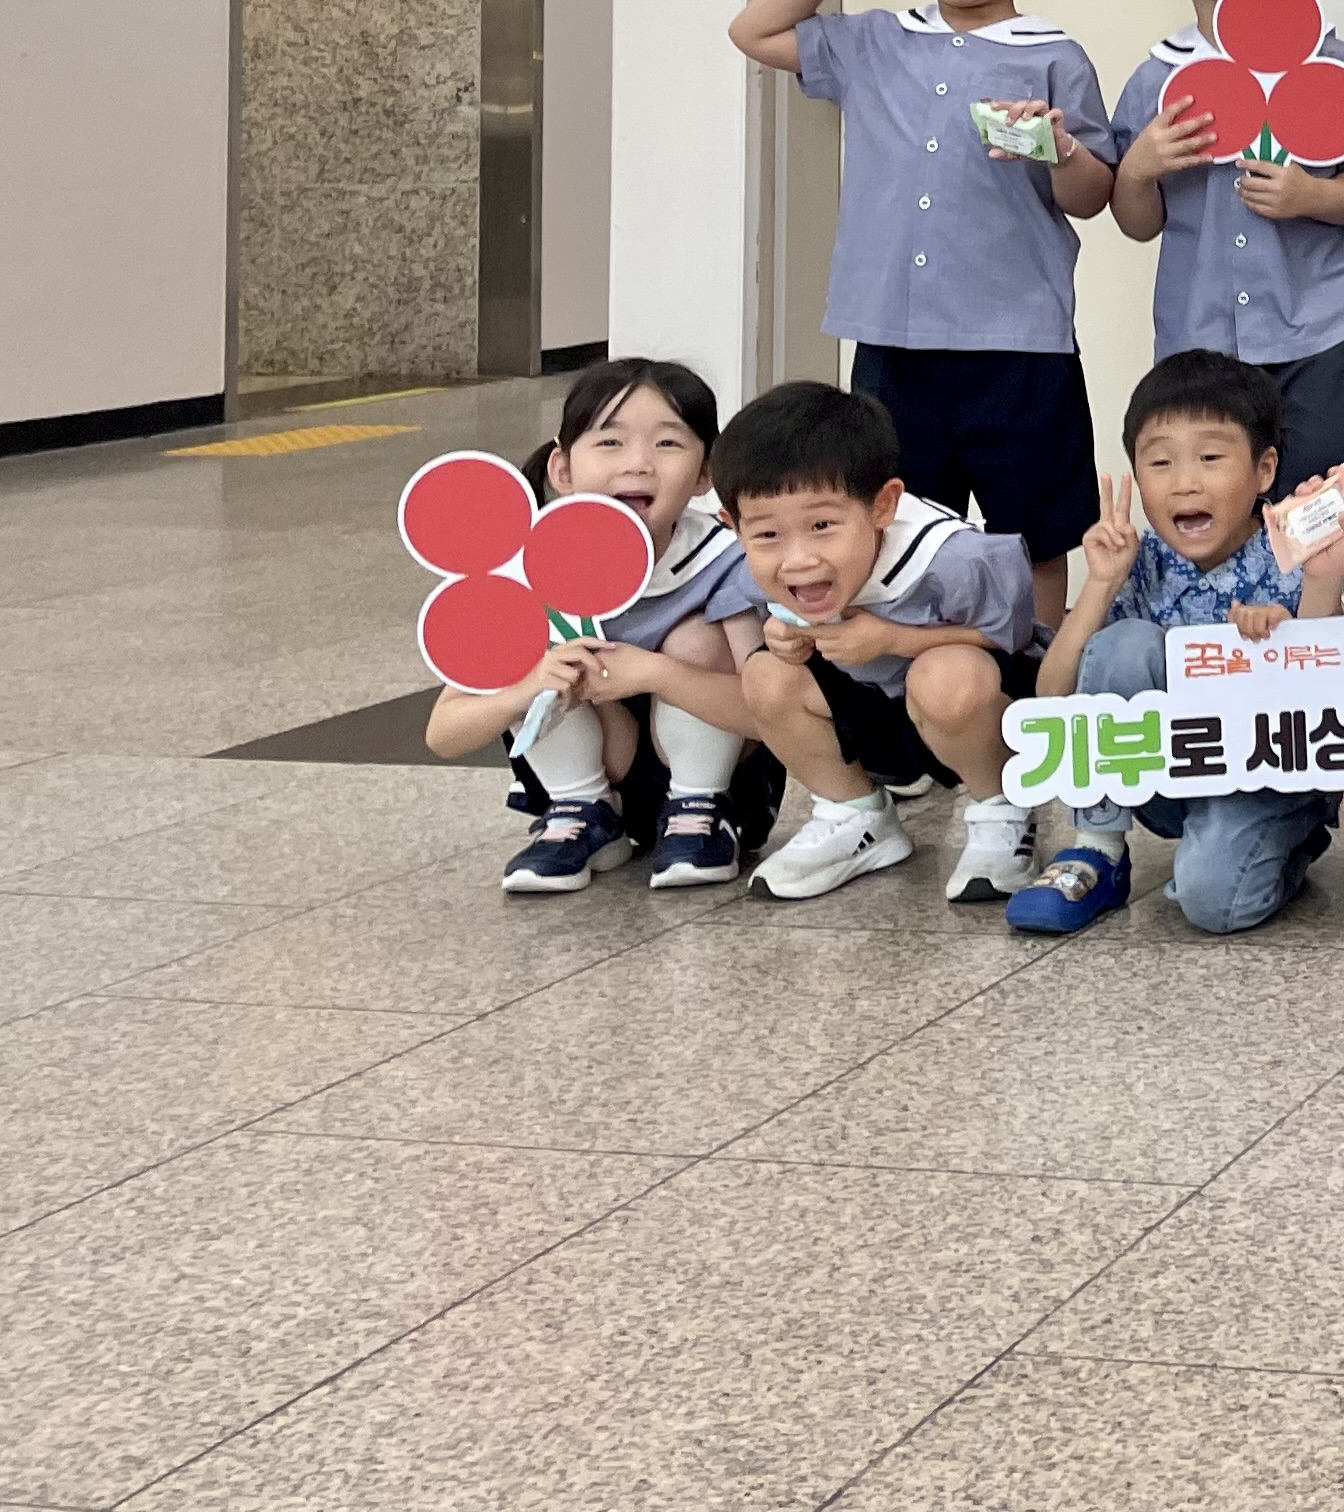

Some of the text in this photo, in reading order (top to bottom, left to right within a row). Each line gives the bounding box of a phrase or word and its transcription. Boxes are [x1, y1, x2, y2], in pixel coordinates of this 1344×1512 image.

[1183, 642, 1253, 677] 꿈을
[1264, 642, 1343, 671] 이루는
[1020, 710, 1226, 789] 기부로
